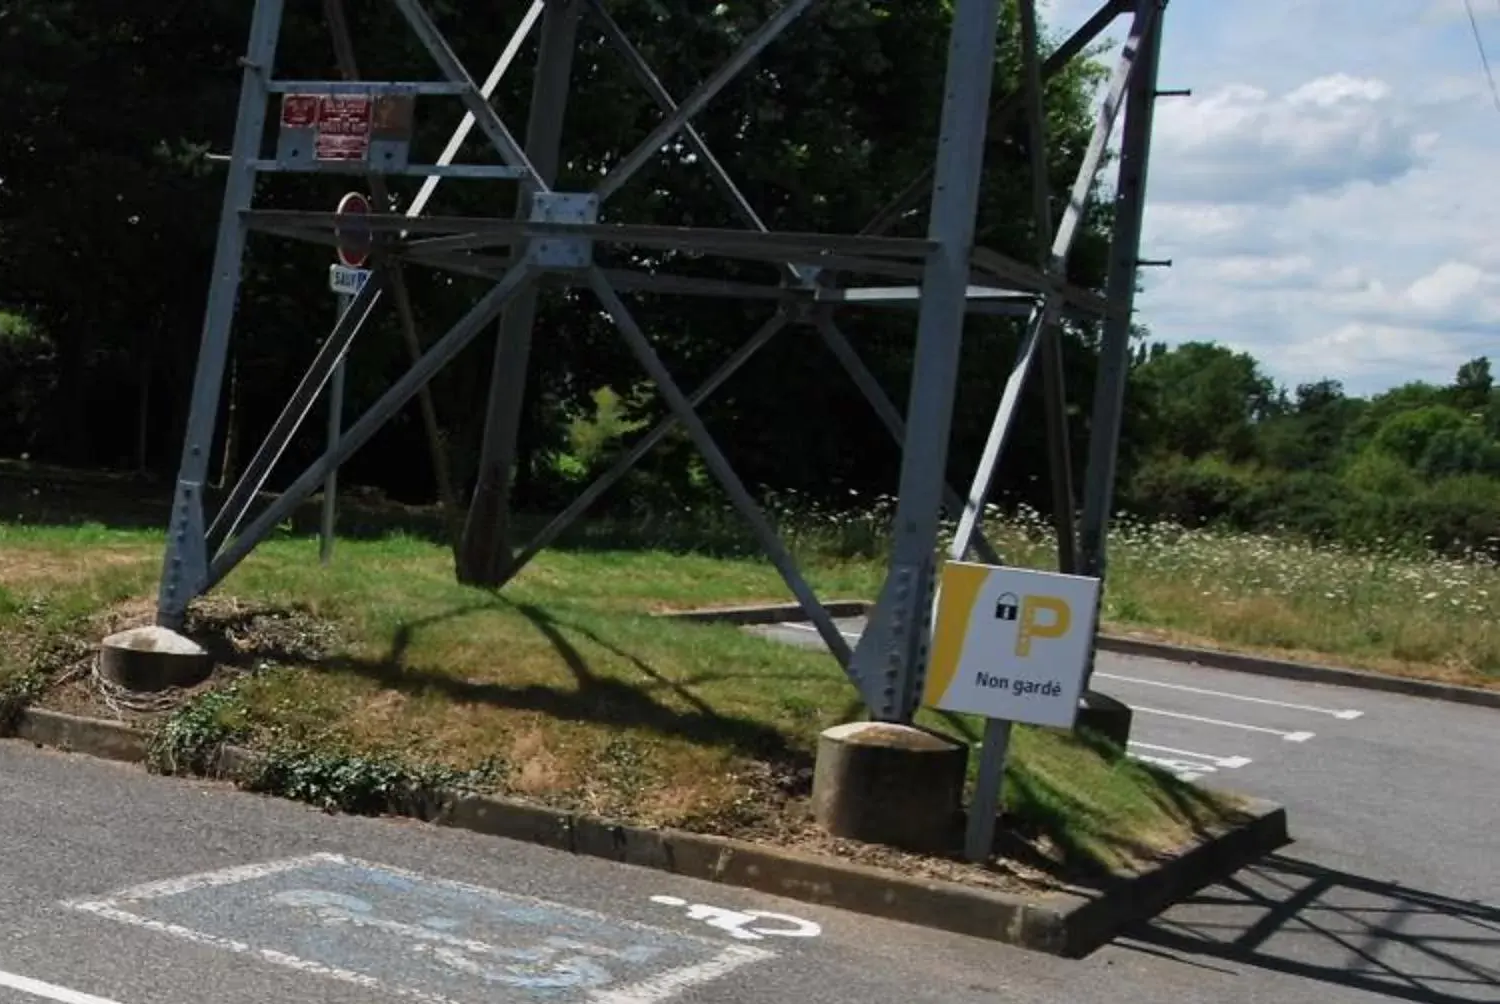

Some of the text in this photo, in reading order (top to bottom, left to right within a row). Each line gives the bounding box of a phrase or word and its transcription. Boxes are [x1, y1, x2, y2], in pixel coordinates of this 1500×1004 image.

[1015, 595, 1072, 656] P
[976, 672, 1061, 697] Non gardé
